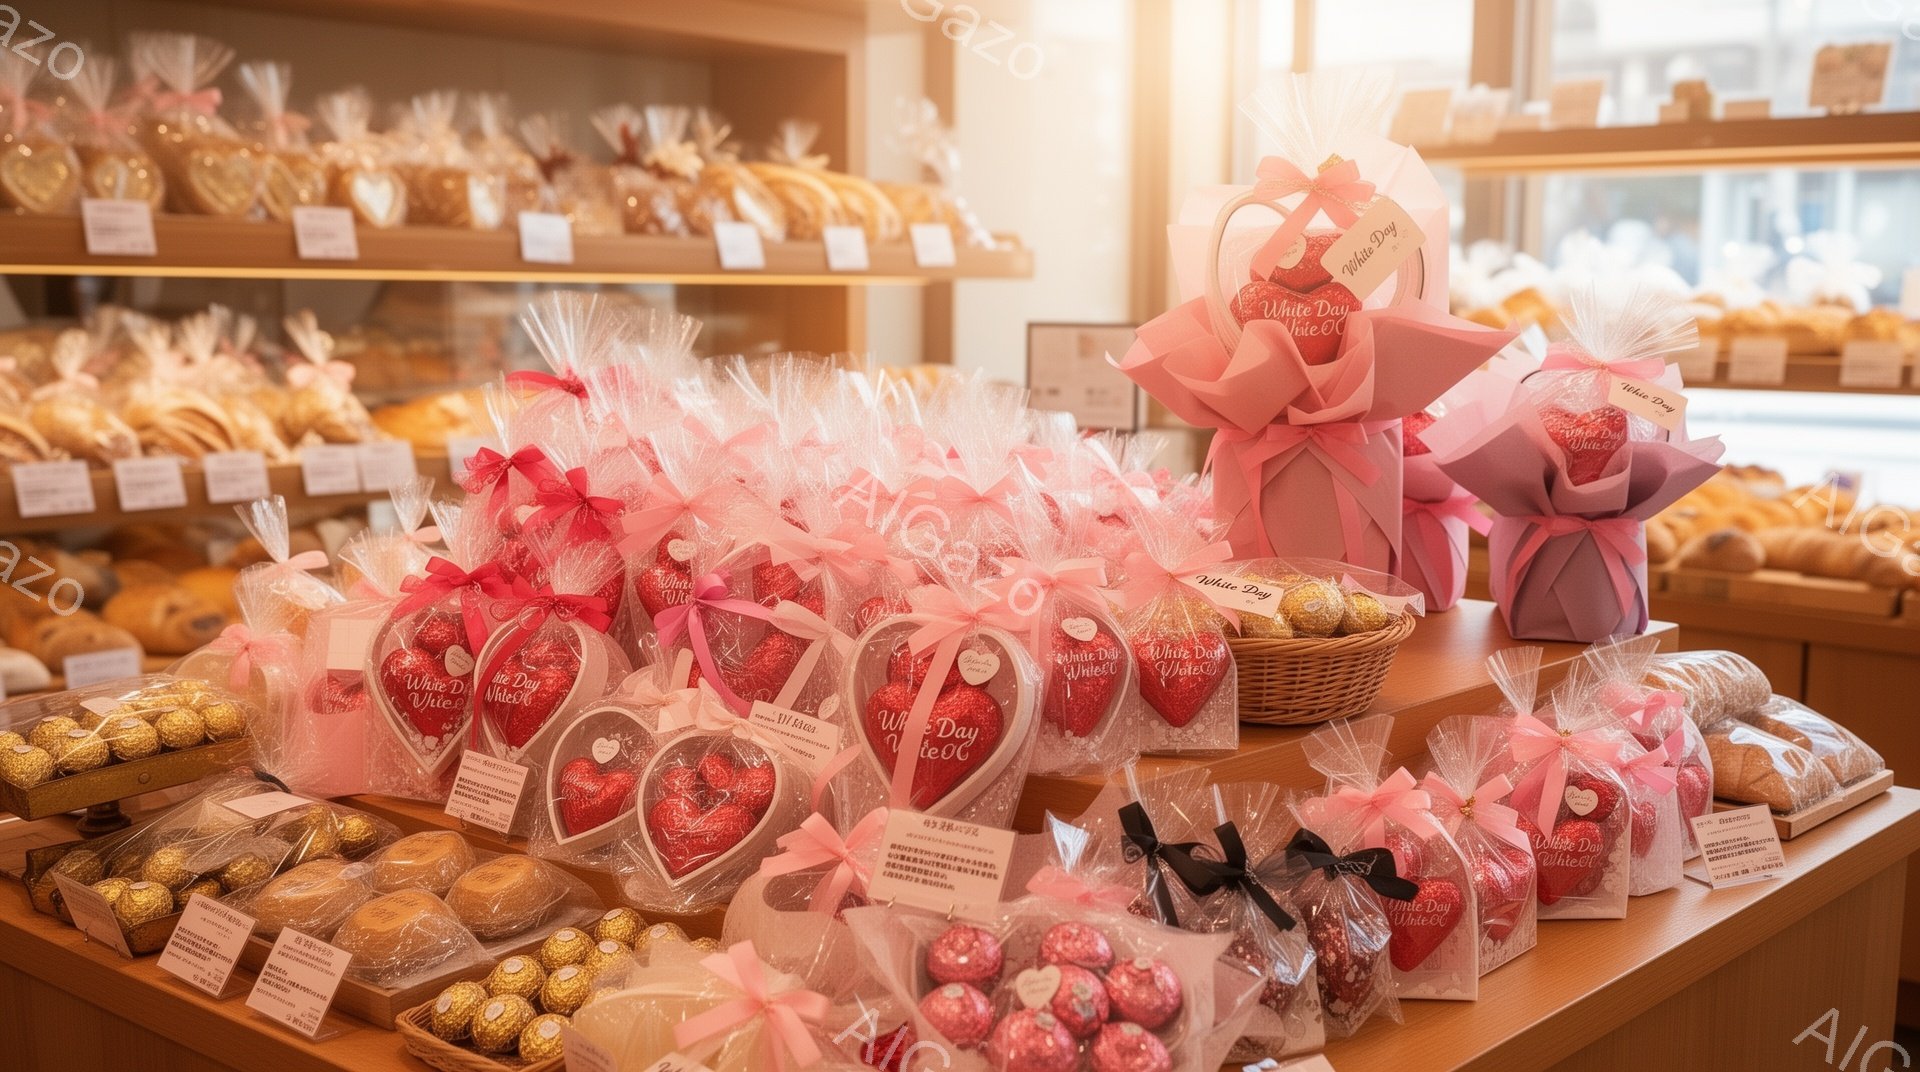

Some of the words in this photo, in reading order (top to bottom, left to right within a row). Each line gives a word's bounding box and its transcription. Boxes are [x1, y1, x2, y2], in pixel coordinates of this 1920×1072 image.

[1342, 245, 1374, 276] White
[1370, 221, 1398, 248] Day
[1258, 300, 1312, 319] White
[1314, 300, 1350, 319] Day
[1196, 575, 1238, 591] White
[1244, 584, 1272, 600] Day
[403, 673, 447, 692] White
[512, 672, 541, 692] Day
[936, 717, 979, 747] Day
[1424, 899, 1451, 914] Day
